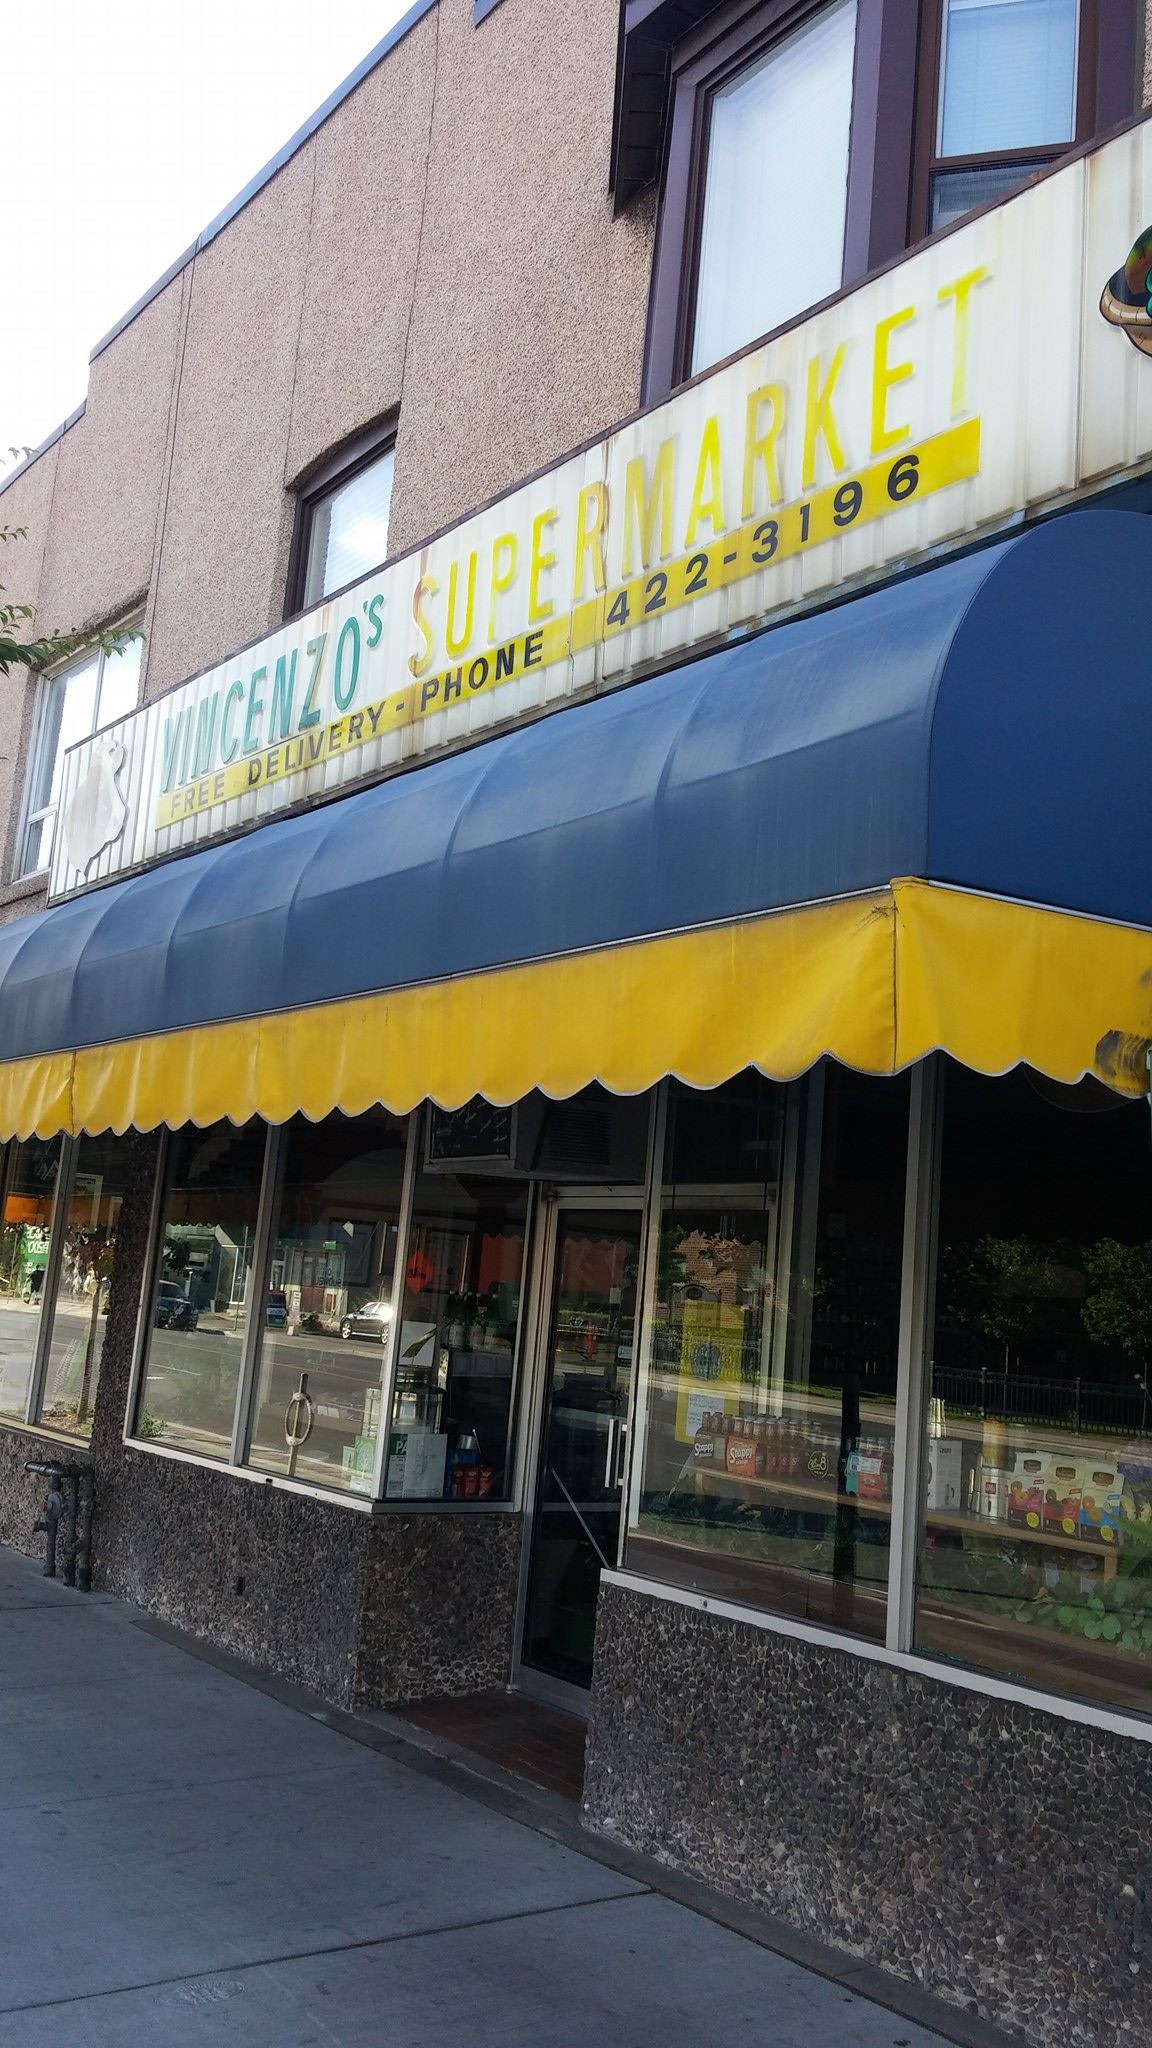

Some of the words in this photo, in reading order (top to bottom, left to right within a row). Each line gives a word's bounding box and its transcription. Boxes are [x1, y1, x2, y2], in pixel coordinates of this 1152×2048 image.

[160, 593, 386, 794] VINCENZO'S
[407, 265, 994, 678] SUPERMARKET
[170, 775, 226, 818] FREE
[247, 704, 384, 786] DELIVERY
[419, 630, 544, 712] PHONE
[606, 454, 920, 626] 422-3196
